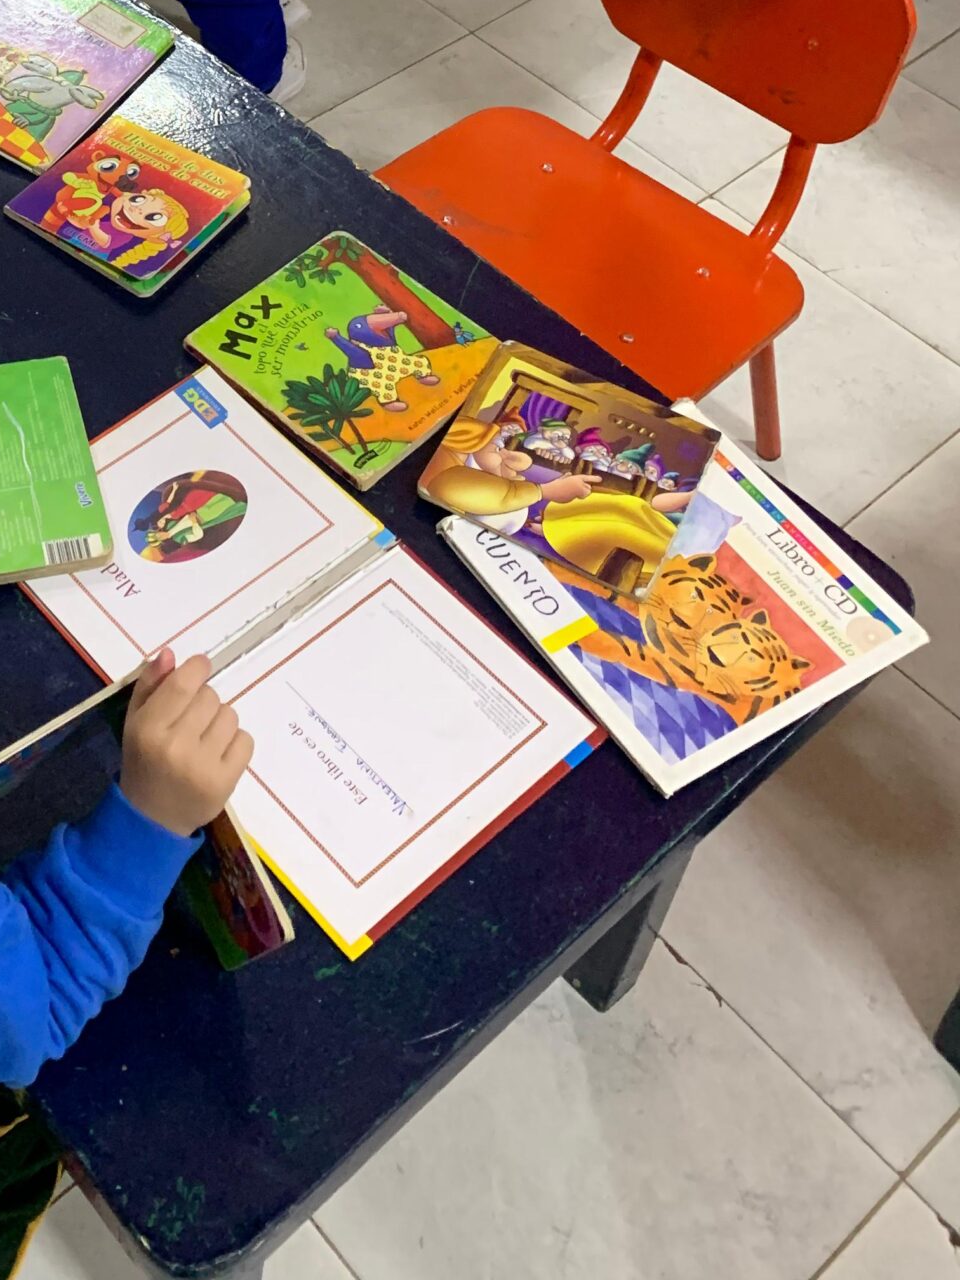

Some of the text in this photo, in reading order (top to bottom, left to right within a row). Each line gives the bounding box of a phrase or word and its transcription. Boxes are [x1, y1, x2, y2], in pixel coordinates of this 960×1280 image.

[123, 132, 226, 186] Historia de dos
[170, 168, 190, 182] de
[218, 294, 283, 361] Max
[258, 322, 268, 334] el
[261, 330, 278, 349] que
[270, 310, 324, 379] ser monstruo
[253, 351, 272, 375] topo
[476, 528, 559, 616] CUENTO
[766, 527, 816, 577] Libro
[823, 583, 859, 616] CD
[766, 569, 856, 658] Juan sin Miedo
[288, 721, 368, 806] Este libro es de
[356, 757, 407, 816] VALENTINA
